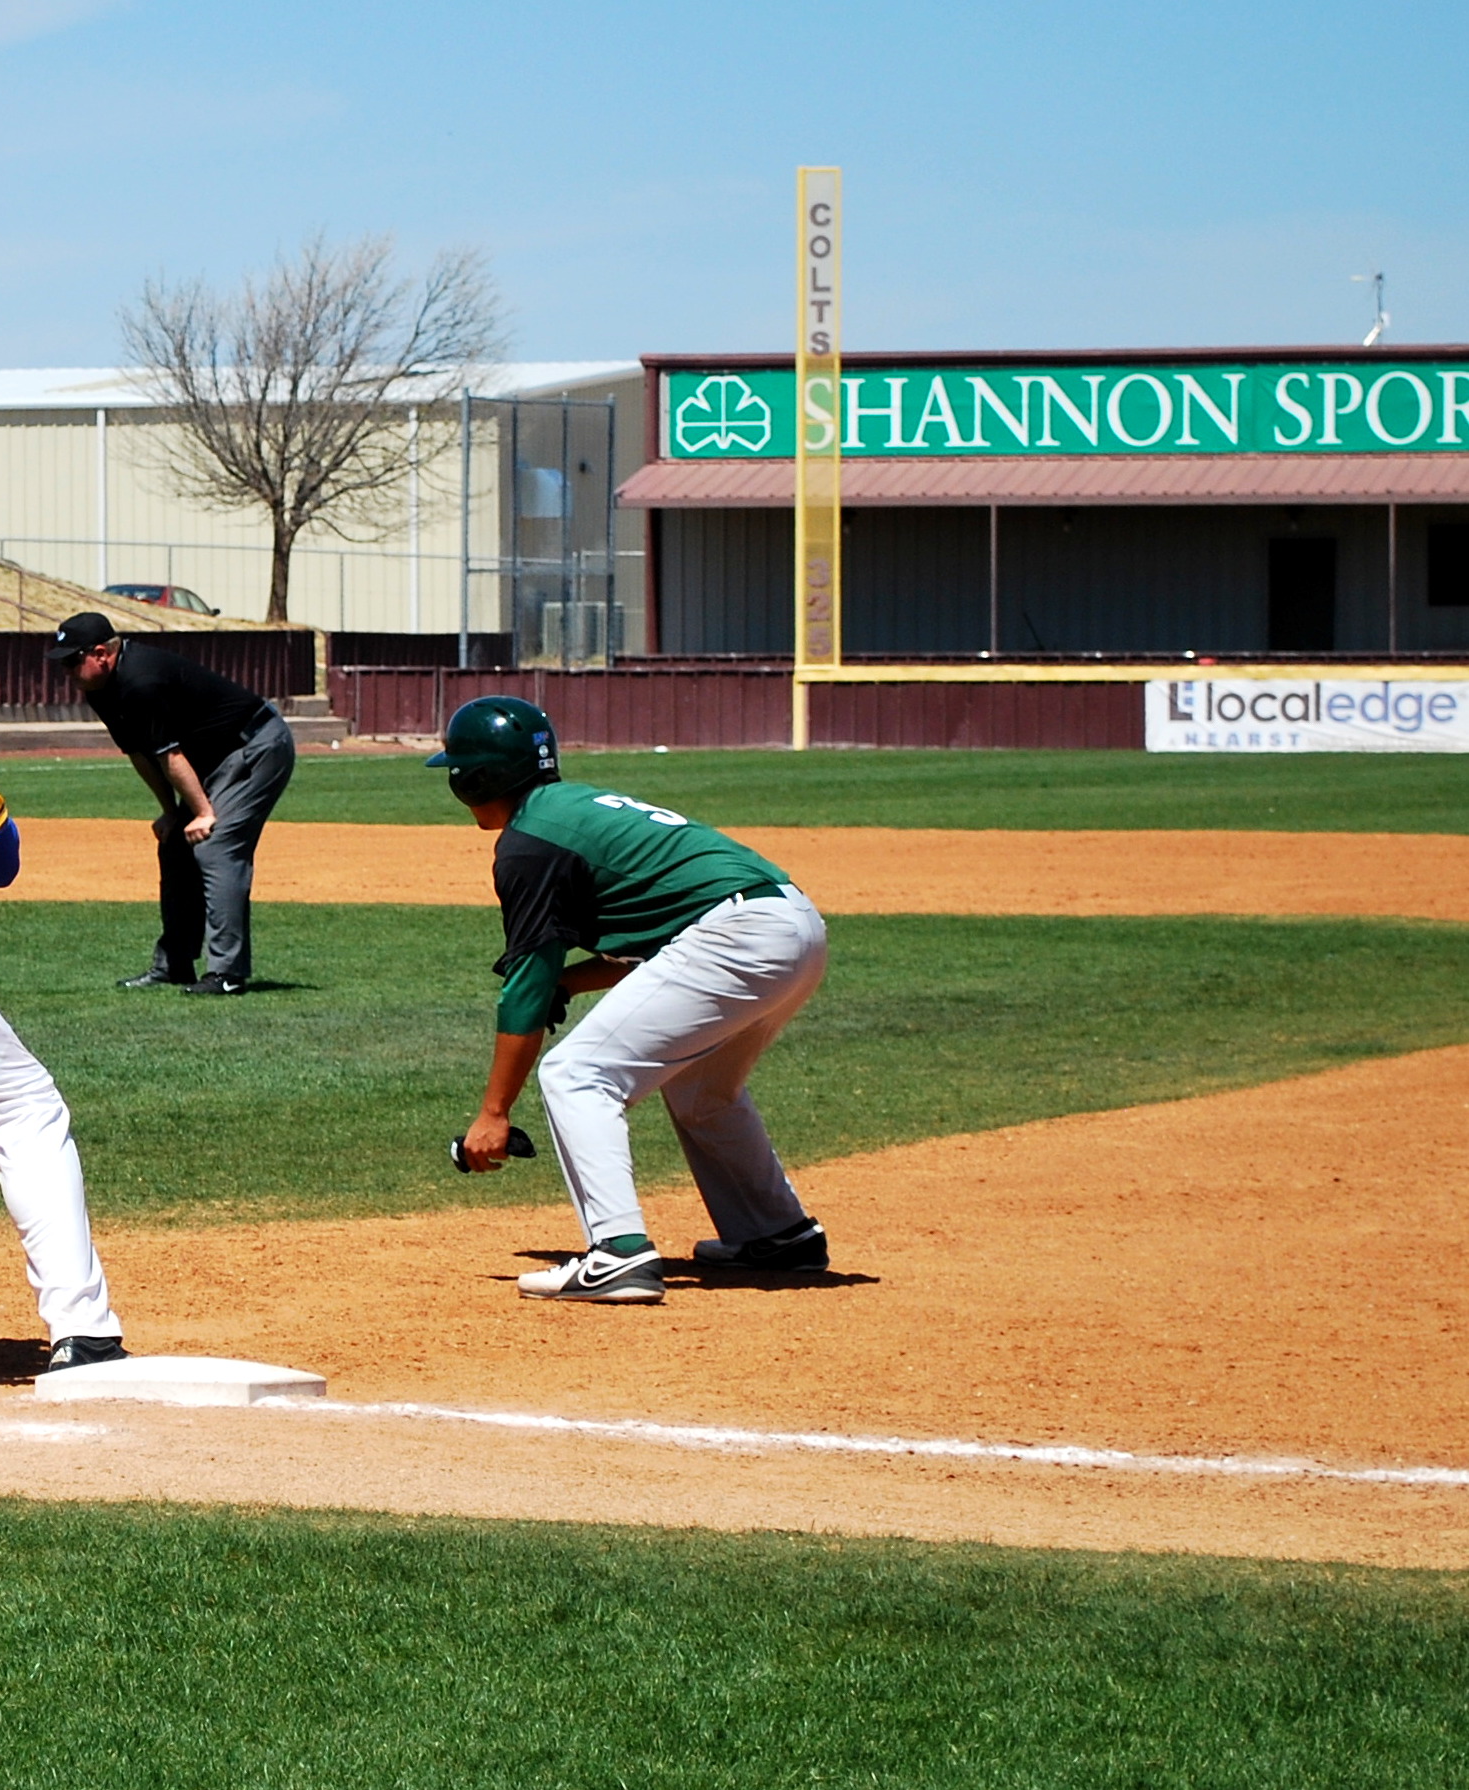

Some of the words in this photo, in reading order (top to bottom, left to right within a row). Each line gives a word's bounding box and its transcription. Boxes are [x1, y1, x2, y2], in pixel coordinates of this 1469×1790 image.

[809, 202, 832, 356] COLTS
[804, 373, 1244, 451] SHANNON
[1185, 733, 1302, 746] HEARST
[1207, 681, 1457, 733] localedge
